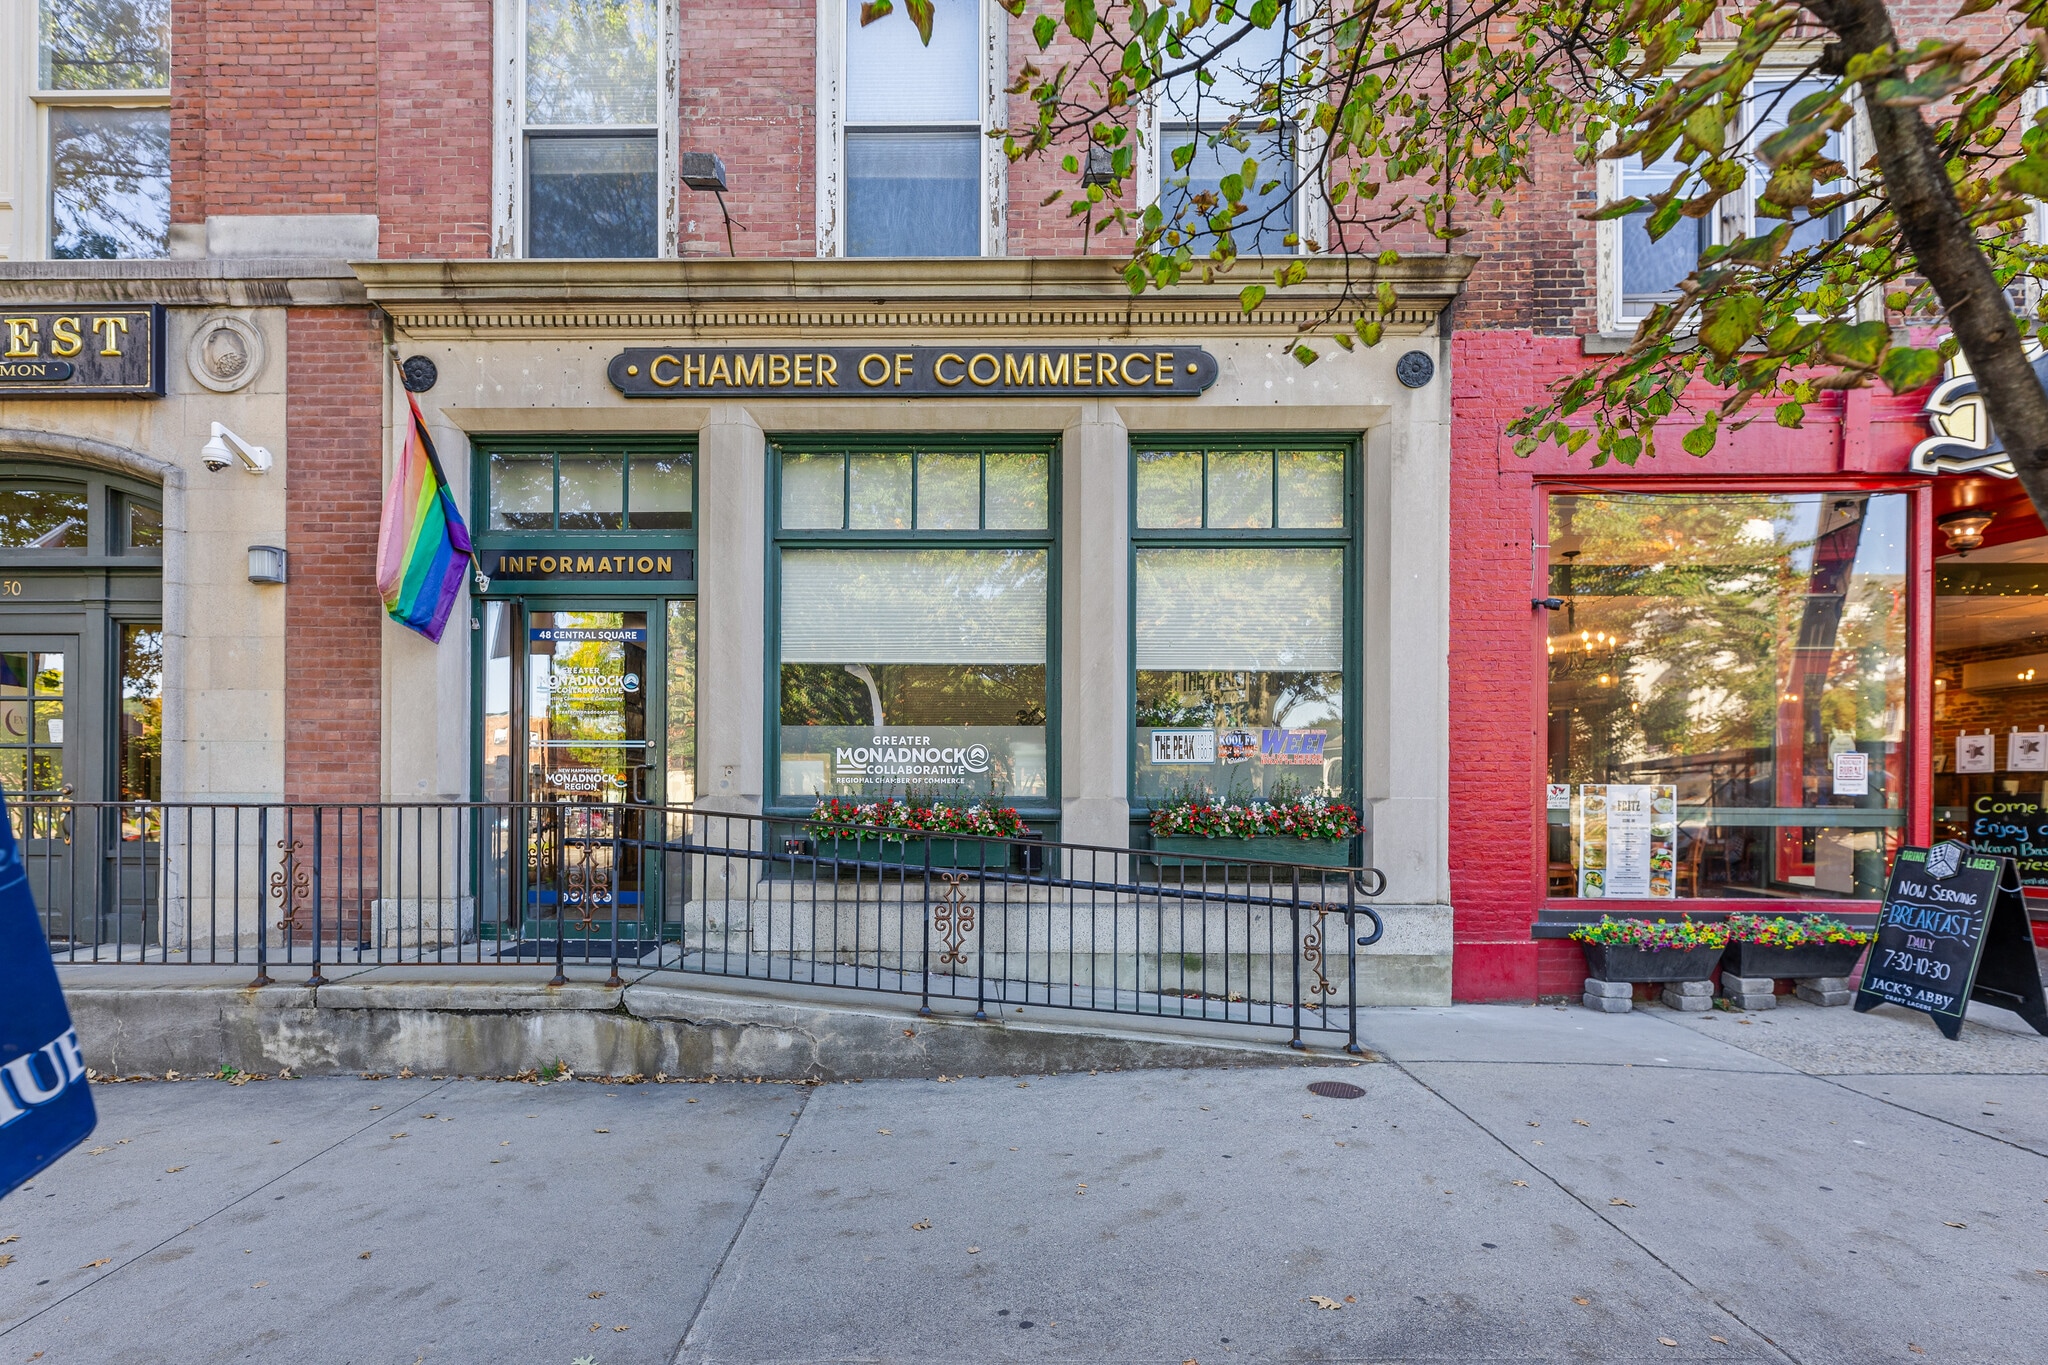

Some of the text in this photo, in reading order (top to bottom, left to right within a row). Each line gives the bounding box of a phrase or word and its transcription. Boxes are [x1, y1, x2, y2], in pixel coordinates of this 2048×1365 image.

[3, 317, 128, 357] EST
[0, 364, 46, 377] MON
[650, 352, 1174, 387] CHAMBER OF COMMERCE
[500, 556, 673, 573] INFORMATION
[2, 580, 22, 596] 50
[539, 630, 637, 641] 48 CENTRAL SQUARE
[563, 667, 600, 675] GREATER
[556, 686, 624, 695] COLLABORATIVE
[872, 736, 931, 746] GREATER
[1155, 736, 1171, 759] THE
[1173, 736, 1195, 759] PEAK
[1218, 735, 1258, 746] KOOL FM
[1262, 730, 1328, 754] WEEI
[836, 747, 967, 768] MONADNOCK
[866, 765, 965, 775] COLLABORATIVE
[545, 774, 617, 786] MONADNOCK
[564, 783, 597, 791] REGION
[1974, 796, 2038, 814] Come
[1974, 818, 2029, 841] Enjoy
[1970, 840, 2017, 855] Warm
[1901, 850, 1997, 871] DRINK LAGER
[2015, 859, 2048, 871] ries
[1898, 880, 1977, 906] NOW SERVING
[1888, 904, 1972, 936] BREAKFAST
[1907, 934, 1935, 950] DAILY
[1883, 949, 1951, 981] 7:30-10:30
[1870, 977, 1954, 1011] JACK'S ABBY
[1884, 994, 1932, 1012] CRAFT LAGERS
